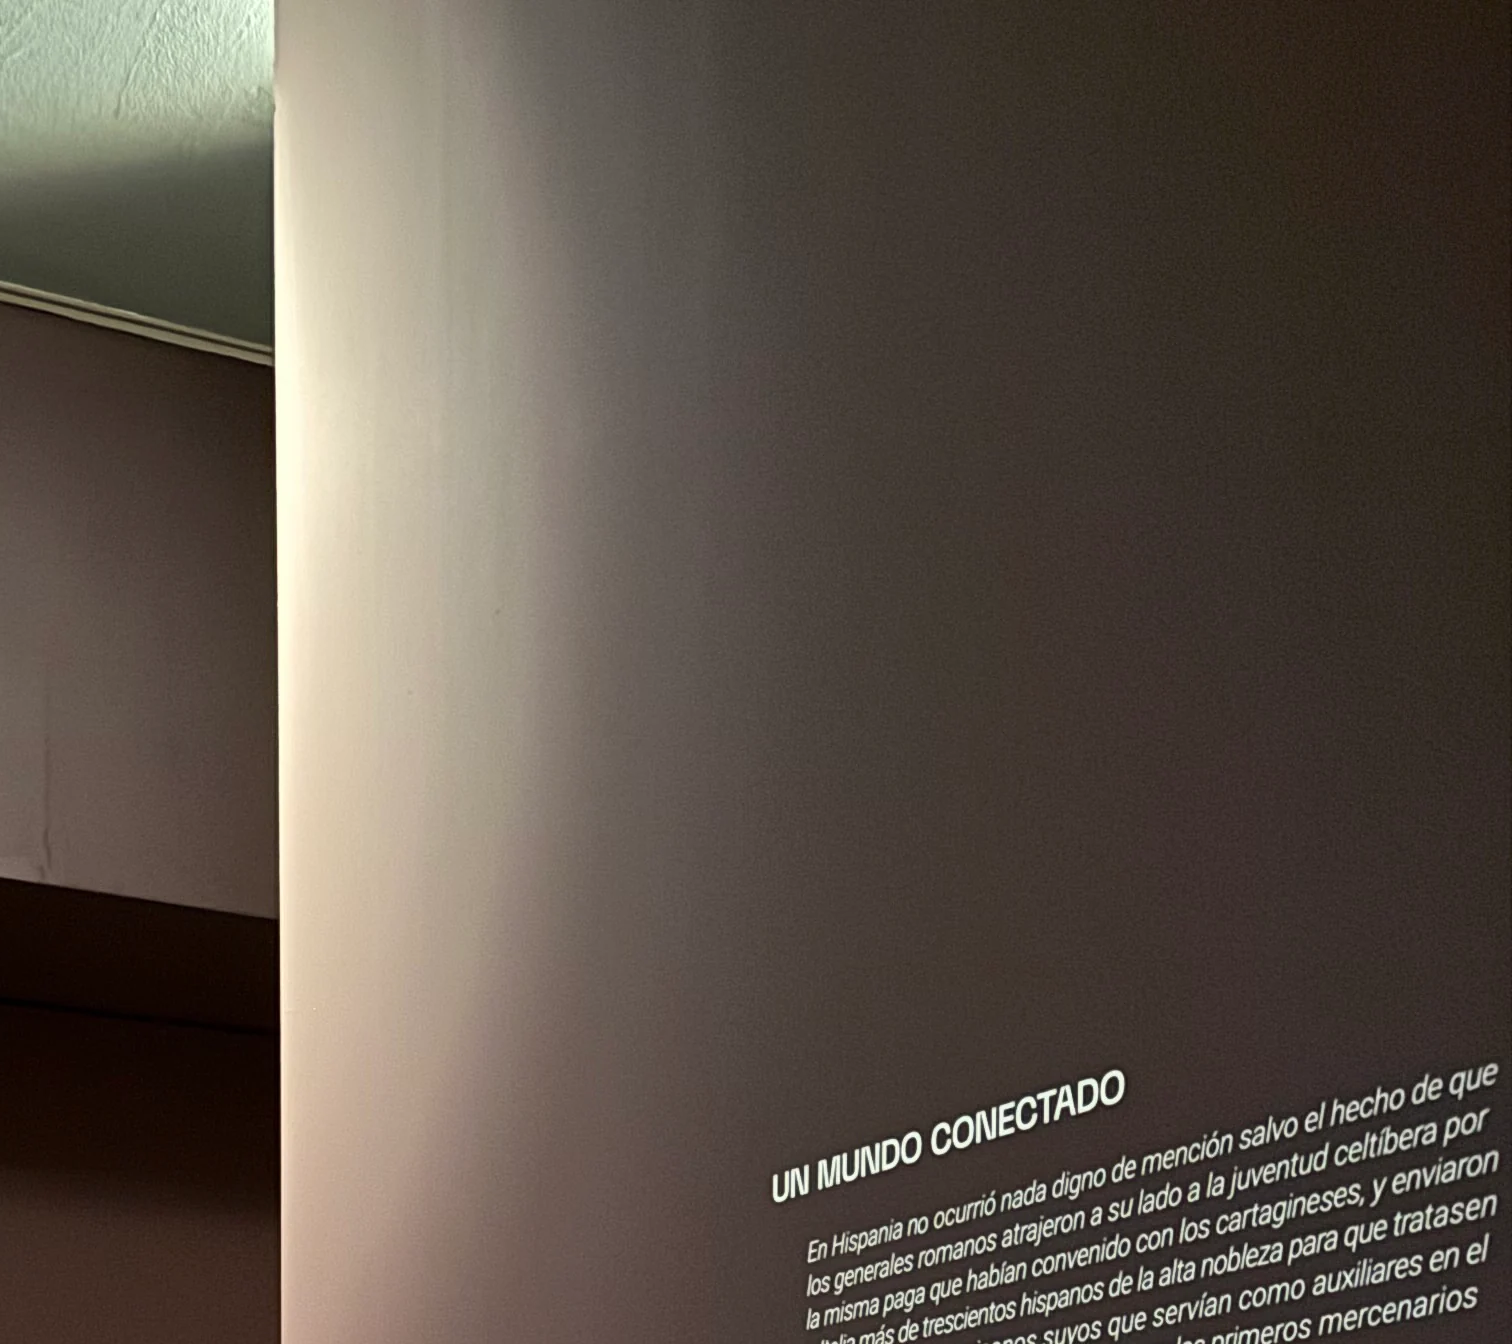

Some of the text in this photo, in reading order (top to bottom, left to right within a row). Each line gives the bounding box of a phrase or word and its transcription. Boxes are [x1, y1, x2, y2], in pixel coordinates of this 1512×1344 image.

[772, 1069, 1125, 1203] UN MUNDO CONECTADO
